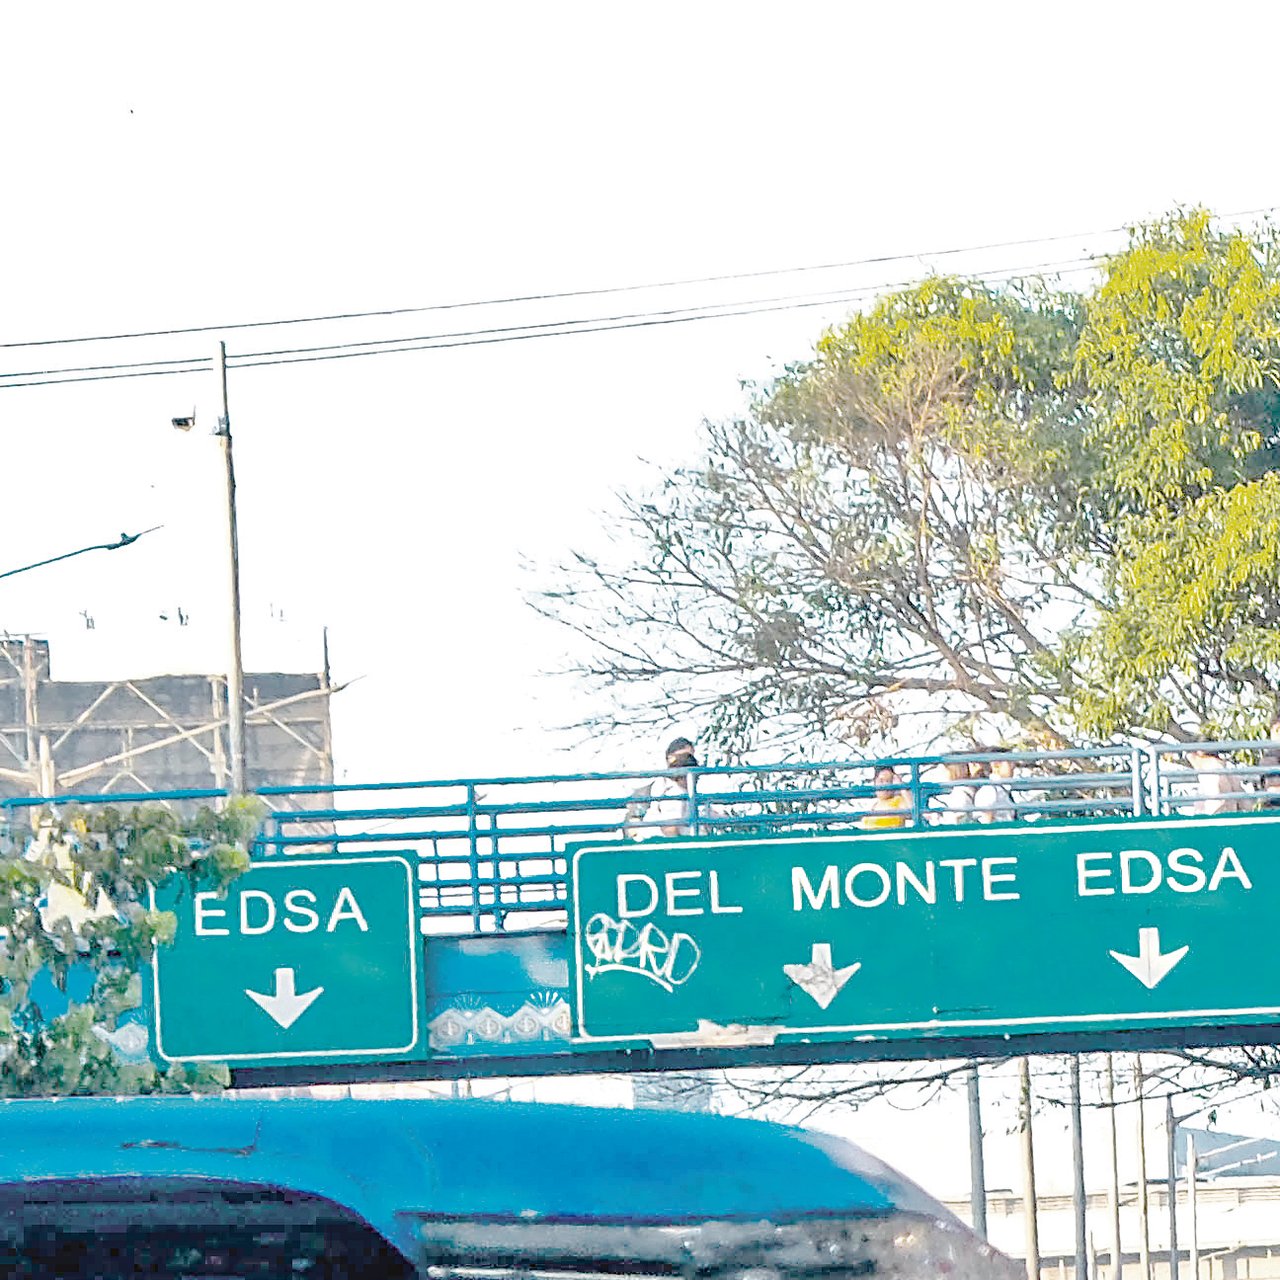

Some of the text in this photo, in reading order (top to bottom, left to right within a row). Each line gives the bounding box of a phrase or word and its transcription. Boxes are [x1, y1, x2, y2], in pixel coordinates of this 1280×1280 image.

[194, 886, 369, 936] EDSA
[617, 870, 743, 919] DEL
[791, 857, 1020, 911] MONTE
[1075, 845, 1253, 897] EDSA
